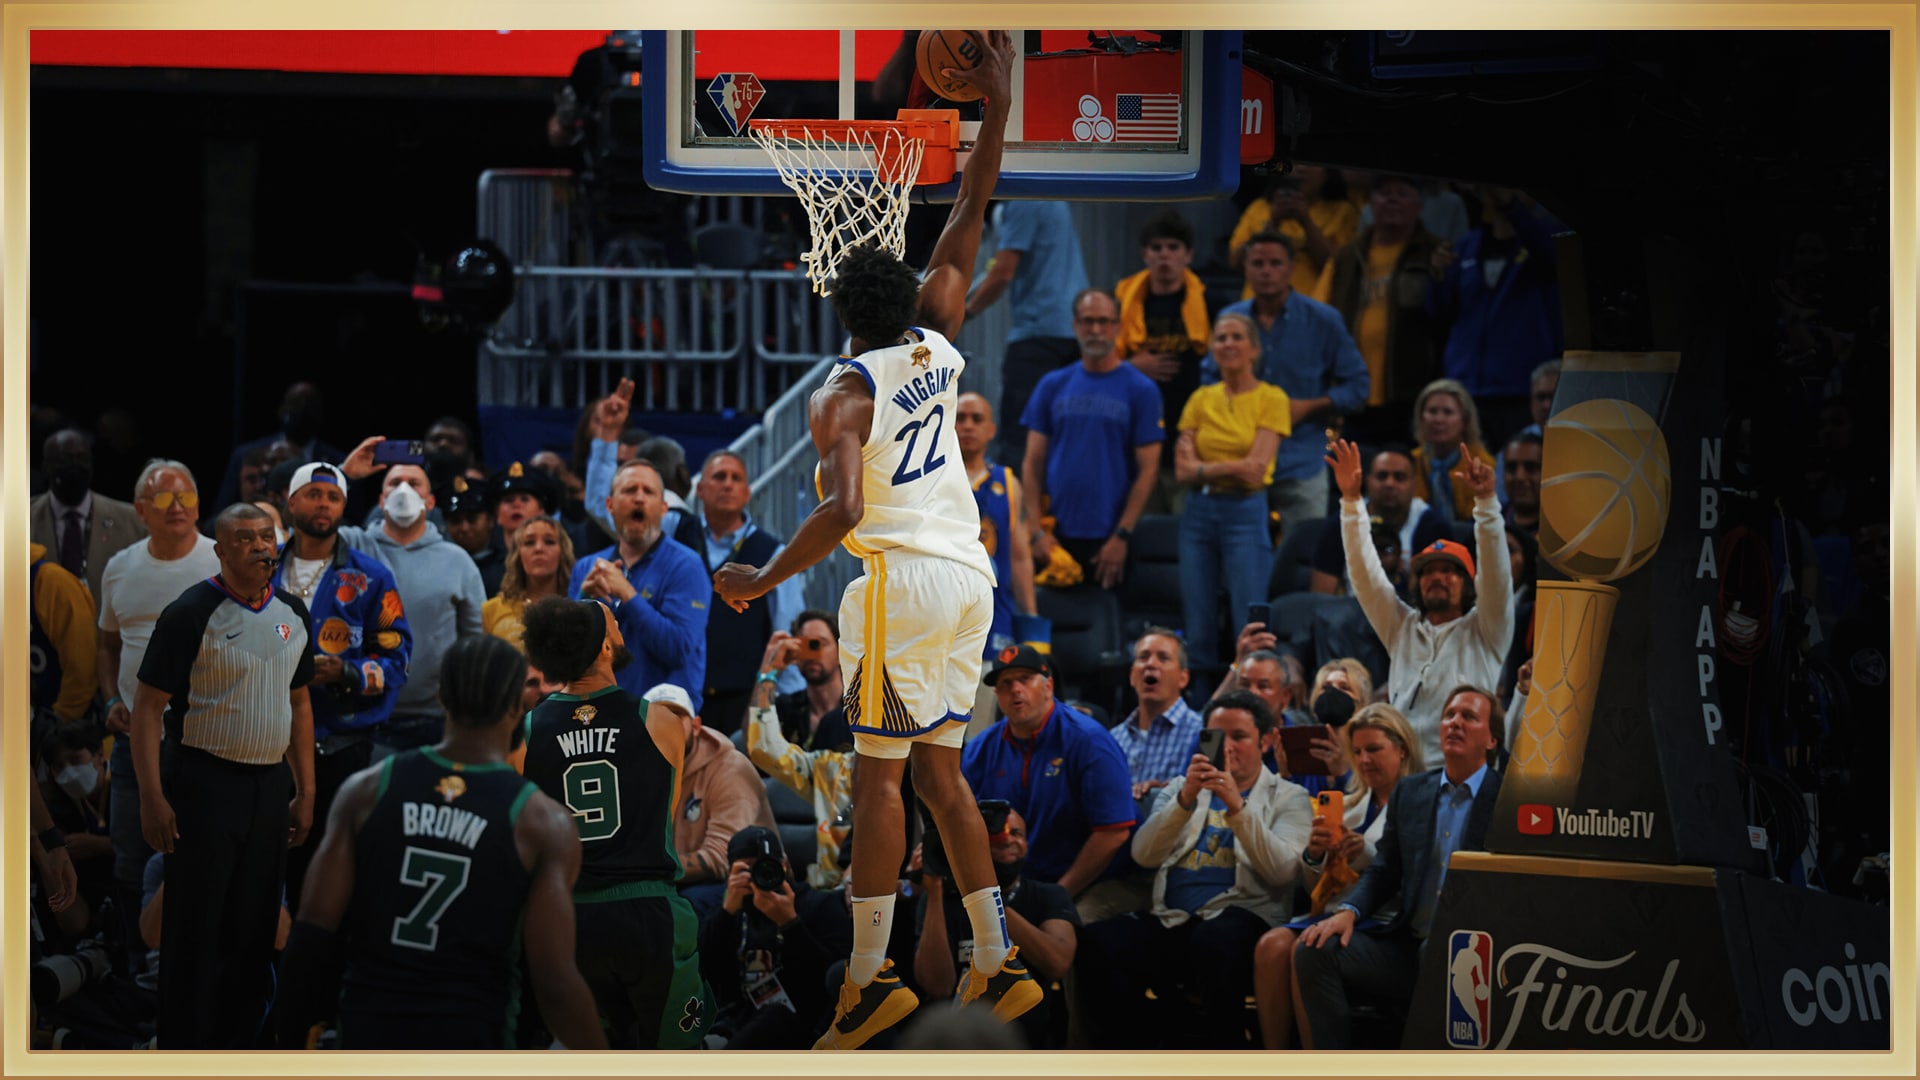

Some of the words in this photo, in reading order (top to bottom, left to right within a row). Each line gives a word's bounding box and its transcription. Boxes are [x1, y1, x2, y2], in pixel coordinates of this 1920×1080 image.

[741, 82, 753, 100] 75
[891, 404, 946, 487] 22
[1696, 437, 1722, 580] NBA
[1695, 604, 1723, 746] APP
[556, 727, 620, 758] WHITE
[402, 801, 489, 850] BROWN
[563, 760, 621, 841] 9
[390, 846, 472, 951] 7
[1496, 943, 1705, 1050] Finals
[1782, 942, 1890, 1026] coin
[1452, 1020, 1474, 1041] NBA
